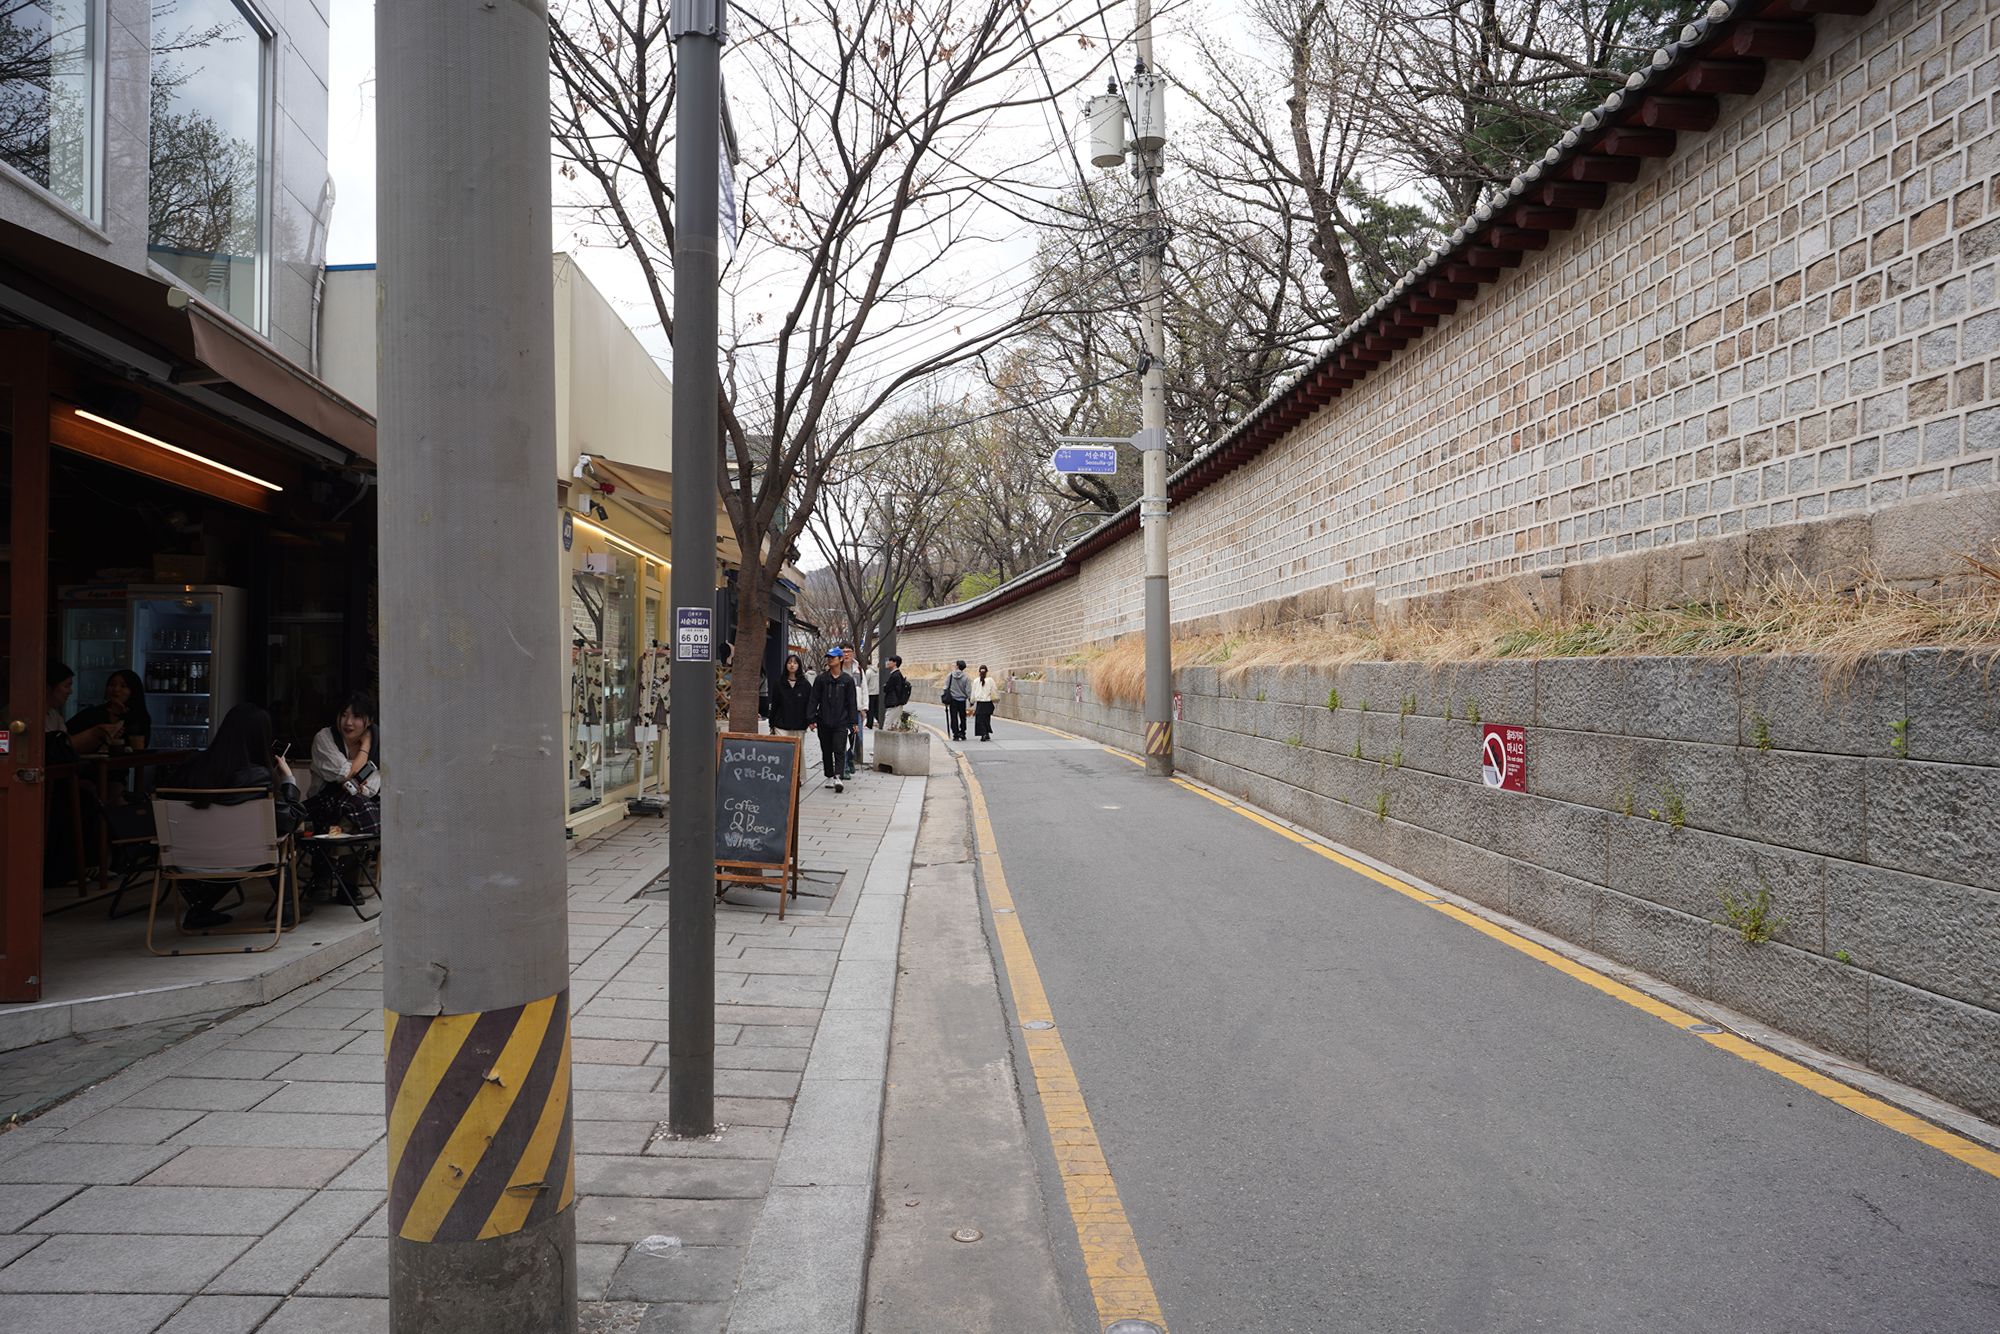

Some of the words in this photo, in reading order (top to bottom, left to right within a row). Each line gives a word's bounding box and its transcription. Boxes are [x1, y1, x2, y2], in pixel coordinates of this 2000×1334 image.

[1085, 451, 1114, 460] 서순라길
[681, 634, 691, 642] 66
[693, 634, 708, 643] 019
[1507, 742, 1524, 755] 마시오
